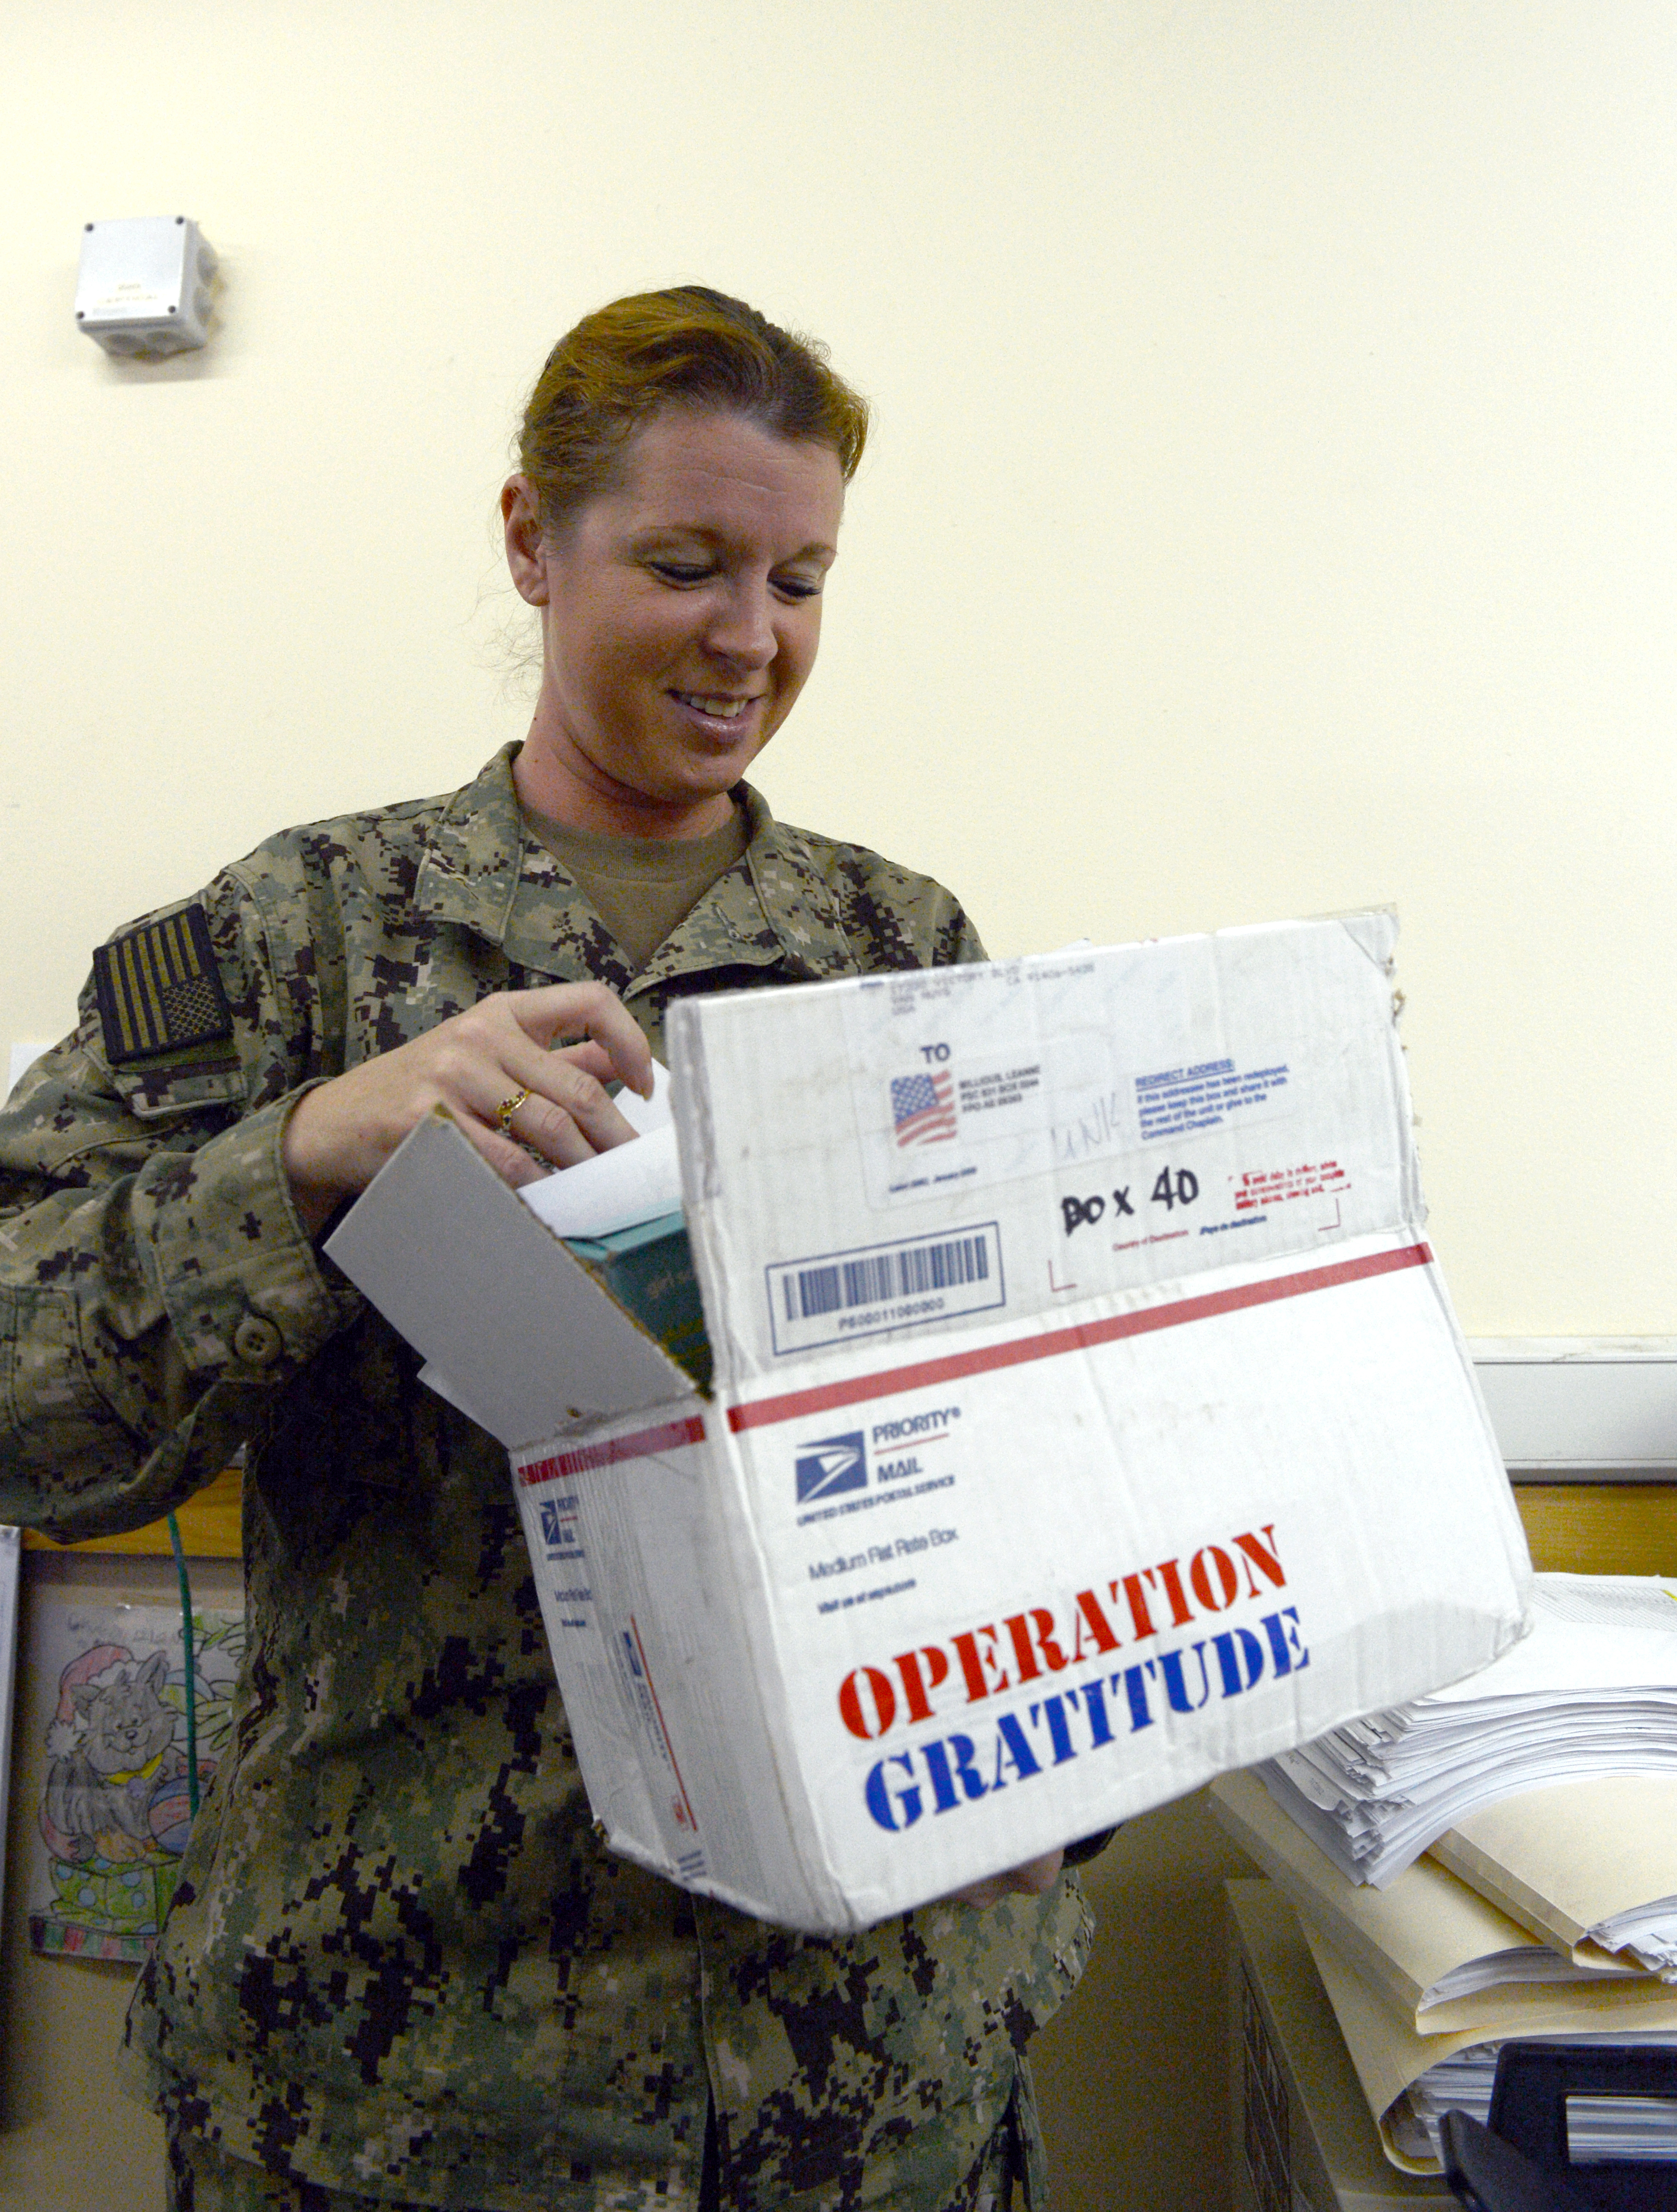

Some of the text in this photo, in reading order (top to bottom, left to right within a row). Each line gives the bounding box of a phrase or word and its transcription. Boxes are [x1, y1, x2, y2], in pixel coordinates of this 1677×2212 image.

[920, 1043, 951, 1063] TO
[1144, 1093, 1160, 1102] this
[1189, 1096, 1205, 1104] this
[1223, 1087, 1238, 1097] and
[1173, 1111, 1182, 1121] of
[1183, 1109, 1197, 1118] the
[1142, 1124, 1185, 1140] Command
[1150, 1165, 1199, 1211] 40
[877, 1457, 922, 1482] MAIL
[797, 1507, 839, 1527] UNITED
[873, 1487, 915, 1505] POSTAL
[914, 1475, 955, 1495] SERVICE
[809, 1529, 958, 1579] Medium Flat Rate Box
[838, 1524, 1287, 1741] OPERATION
[865, 1606, 1310, 1832] GRATITUDE
